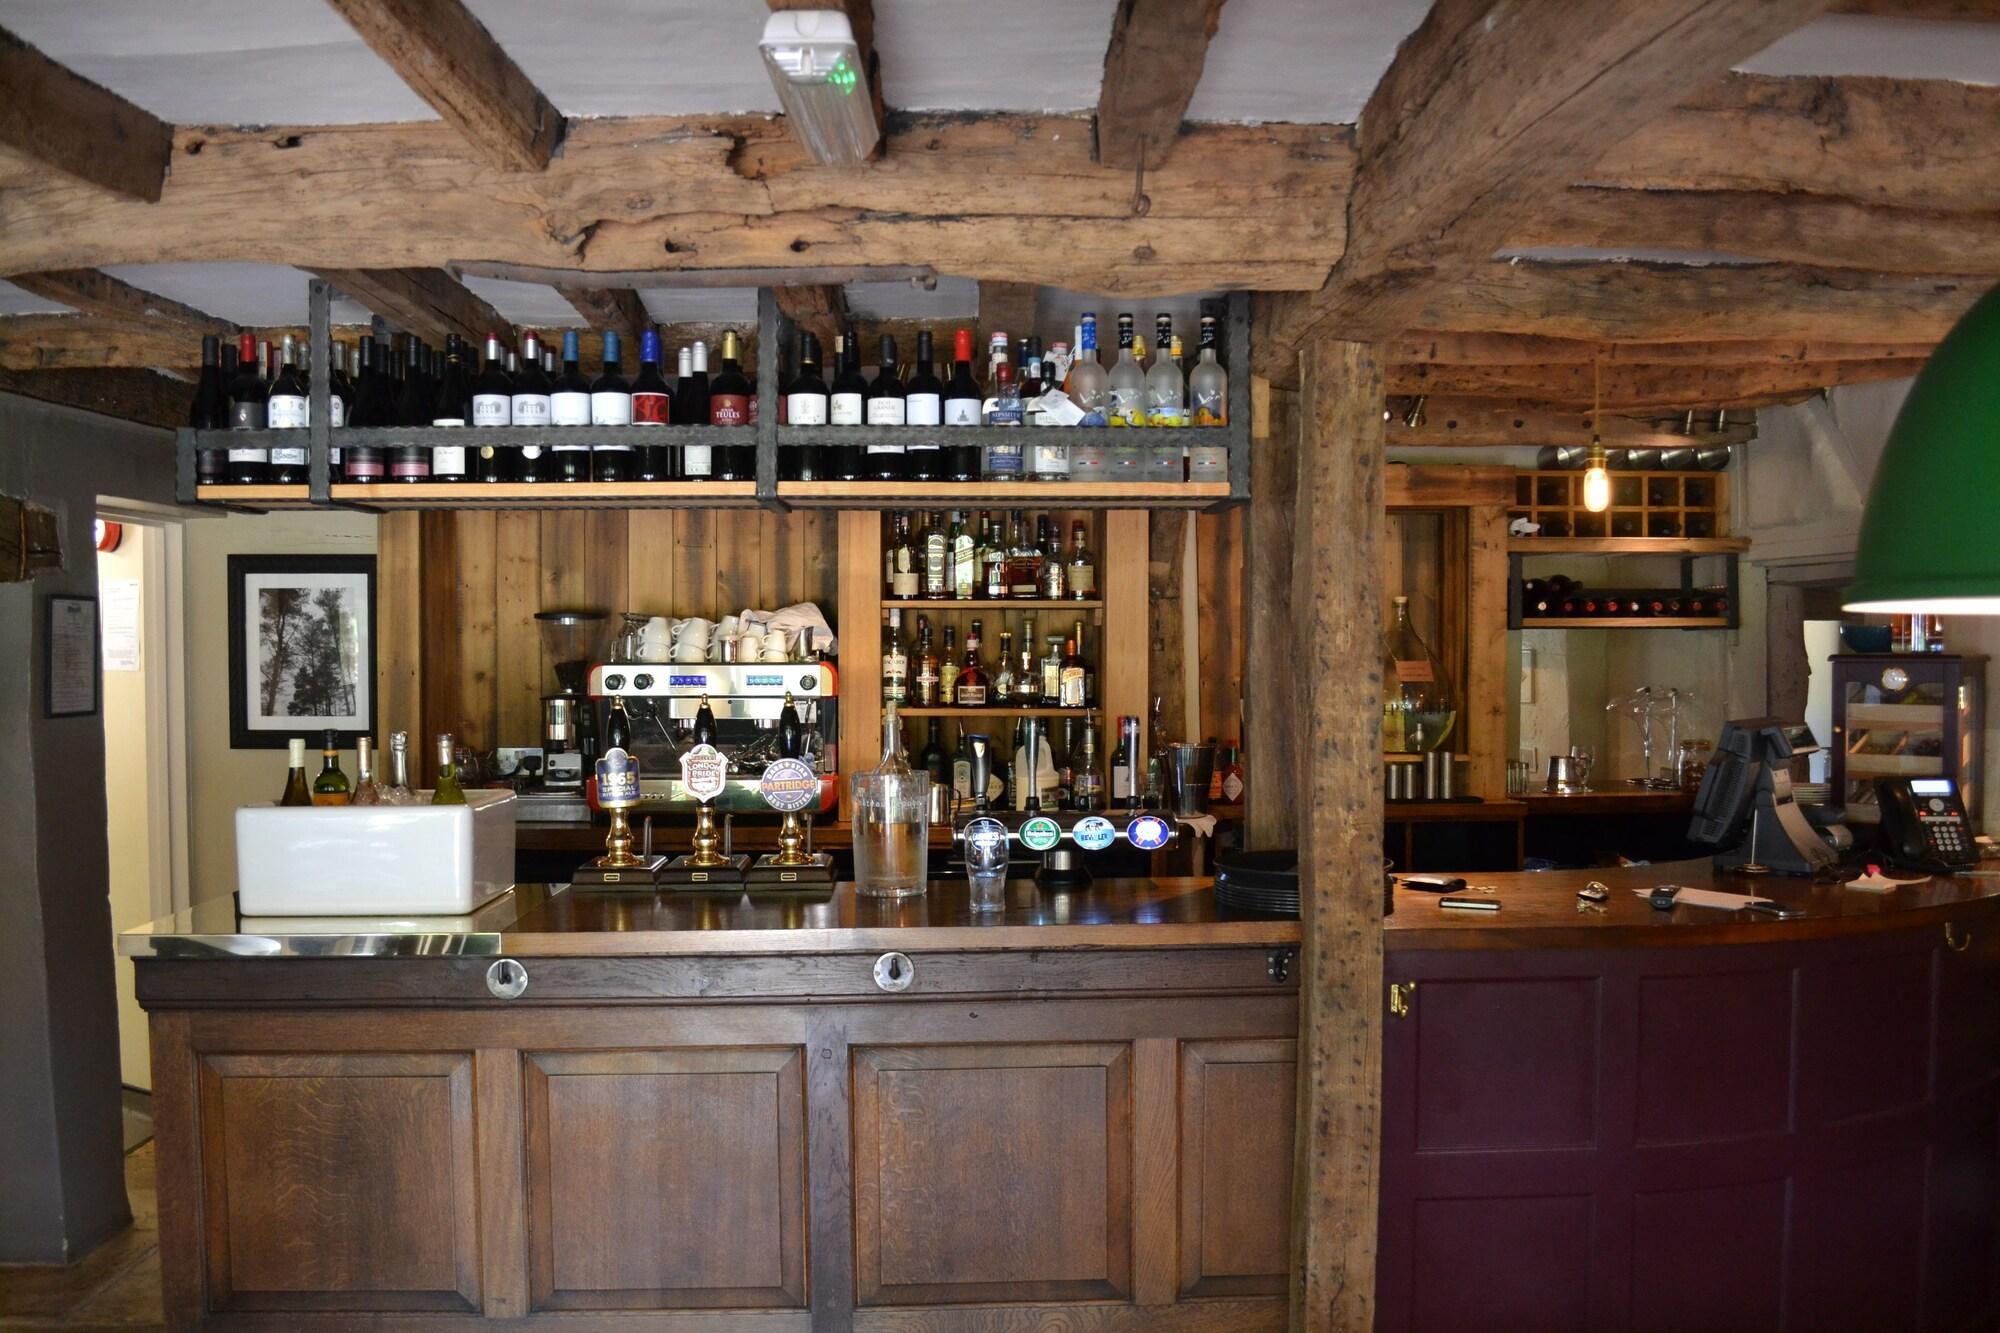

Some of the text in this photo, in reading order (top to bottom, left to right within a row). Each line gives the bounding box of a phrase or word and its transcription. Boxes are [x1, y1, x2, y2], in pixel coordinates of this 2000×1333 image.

[688, 762, 721, 771] LONDON
[766, 762, 808, 780] DARK STAR
[601, 770, 636, 786] 1965
[692, 770, 717, 778] PRIDE
[760, 779, 816, 791] PARTRIDGE
[767, 793, 811, 809] BEST BITTER
